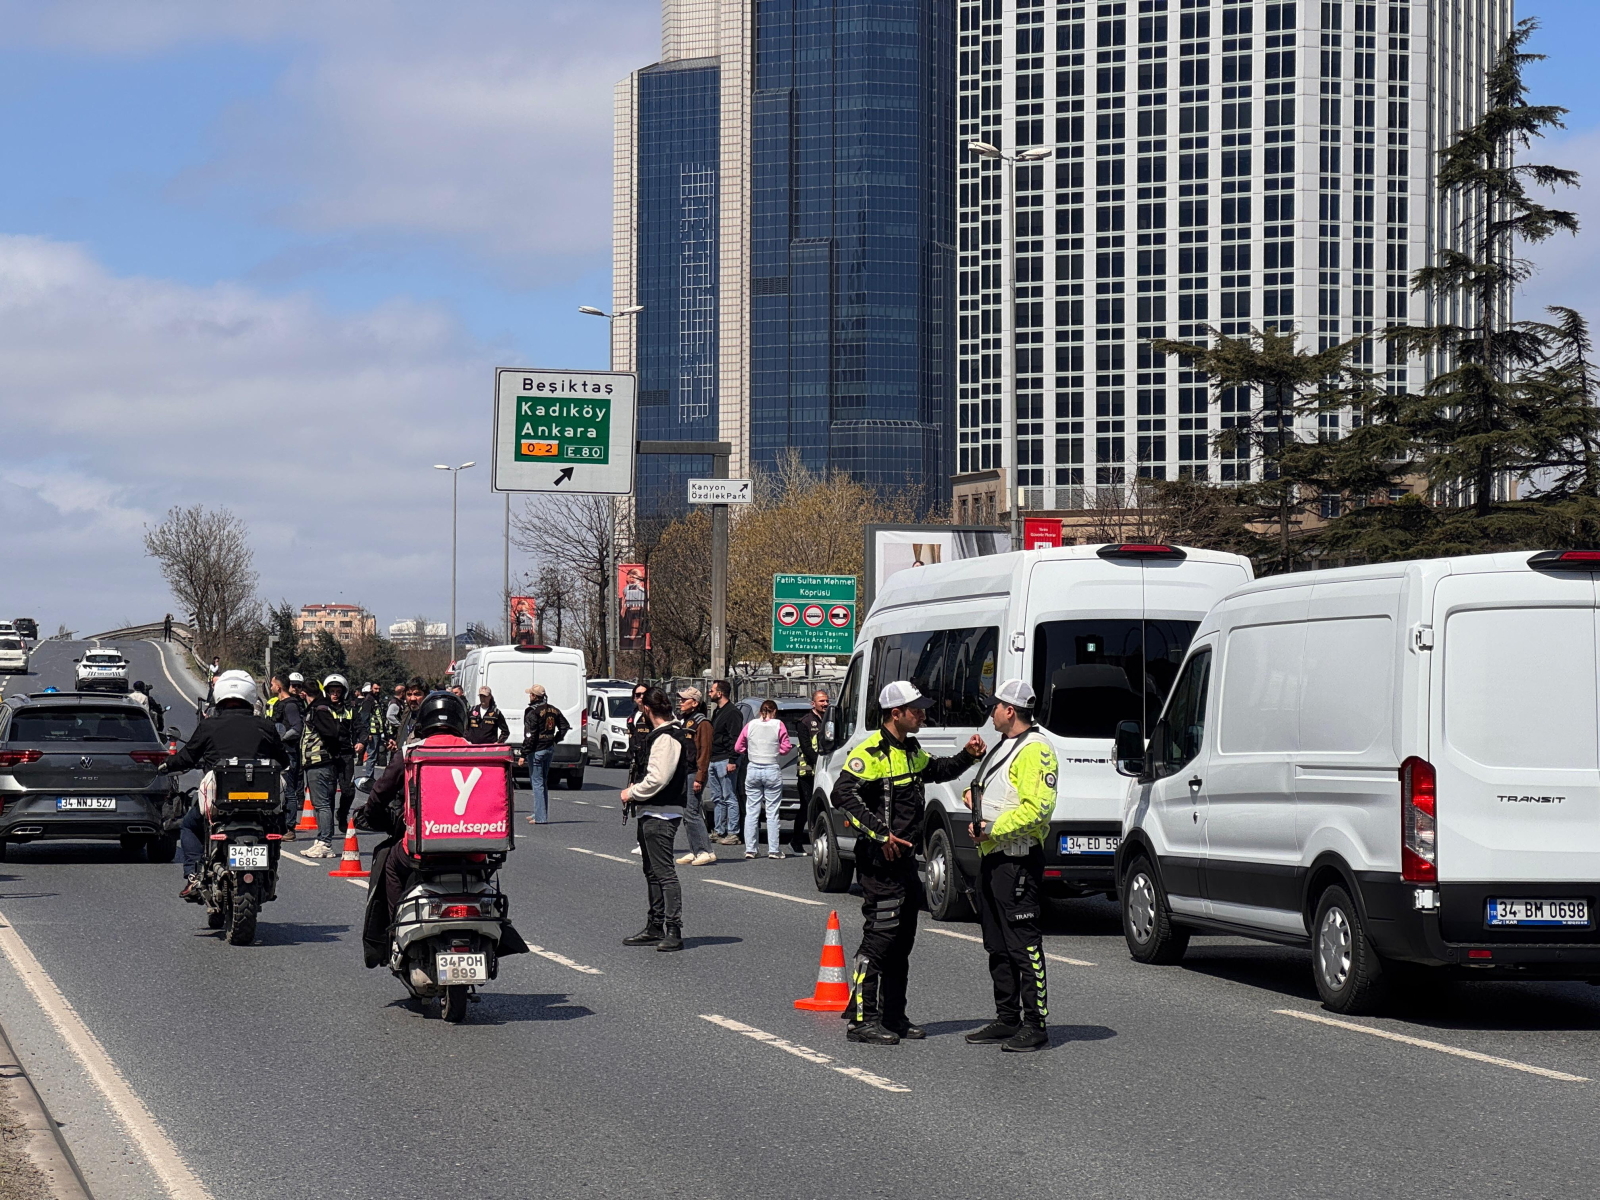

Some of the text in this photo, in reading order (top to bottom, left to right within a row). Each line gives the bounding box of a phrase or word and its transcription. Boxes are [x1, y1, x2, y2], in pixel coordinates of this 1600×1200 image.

[522, 378, 614, 395] Beşiktaş
[521, 401, 607, 422] Kadıköy
[521, 421, 597, 438] Ankara
[691, 483, 726, 492] Kanyon
[776, 576, 855, 586] Fatih Sultan Mehmet
[800, 588, 831, 597] Köprüsü
[451, 767, 483, 816] Y
[62, 797, 113, 808] 34 NNJ 527
[1497, 795, 1567, 804] TRANSIT
[424, 820, 507, 836] Yemeksepeti
[1068, 837, 1082, 850] 34
[1087, 837, 1101, 850] ED
[231, 847, 266, 857] 34 MGZ
[238, 858, 258, 867] 686
[1499, 901, 1586, 919] 34 BM 0698
[451, 967, 477, 979] 899
